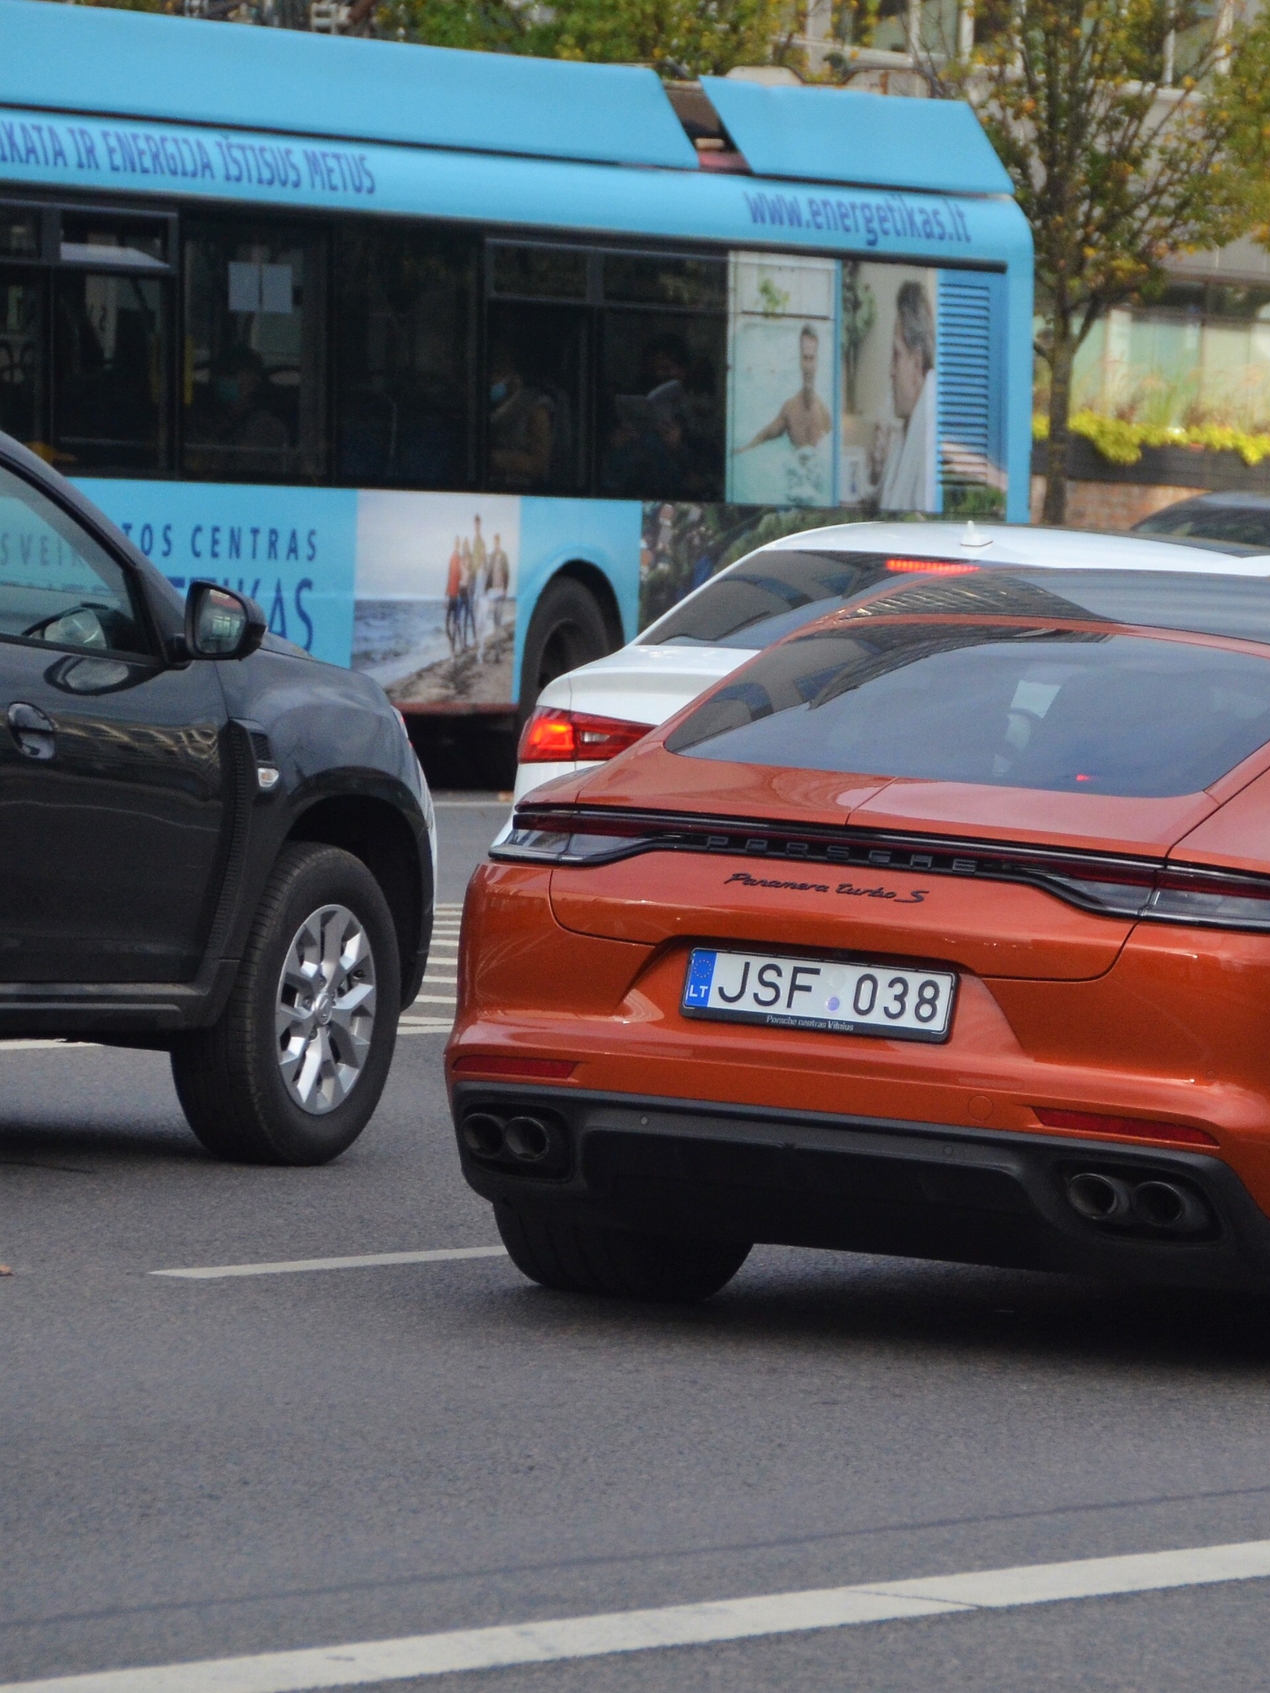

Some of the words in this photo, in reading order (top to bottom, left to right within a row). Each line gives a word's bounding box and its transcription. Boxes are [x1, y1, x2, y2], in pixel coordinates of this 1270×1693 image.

[67, 127, 99, 169] IR
[100, 130, 215, 180] ENERGIJA
[215, 134, 301, 188] IŠTISUS
[302, 149, 375, 195] METUS
[743, 190, 971, 247] www.energetikas.lt
[191, 524, 316, 562] CENTRAS
[706, 835, 977, 873] PORSCHE
[724, 872, 829, 893] Panamera
[835, 882, 897, 899] turbo
[894, 890, 930, 903] S
[689, 985, 708, 998] LT
[717, 961, 821, 1009] JSF
[852, 973, 941, 1024] 038
[766, 1014, 798, 1025] Porsche
[827, 1021, 854, 1031] Vilnius
